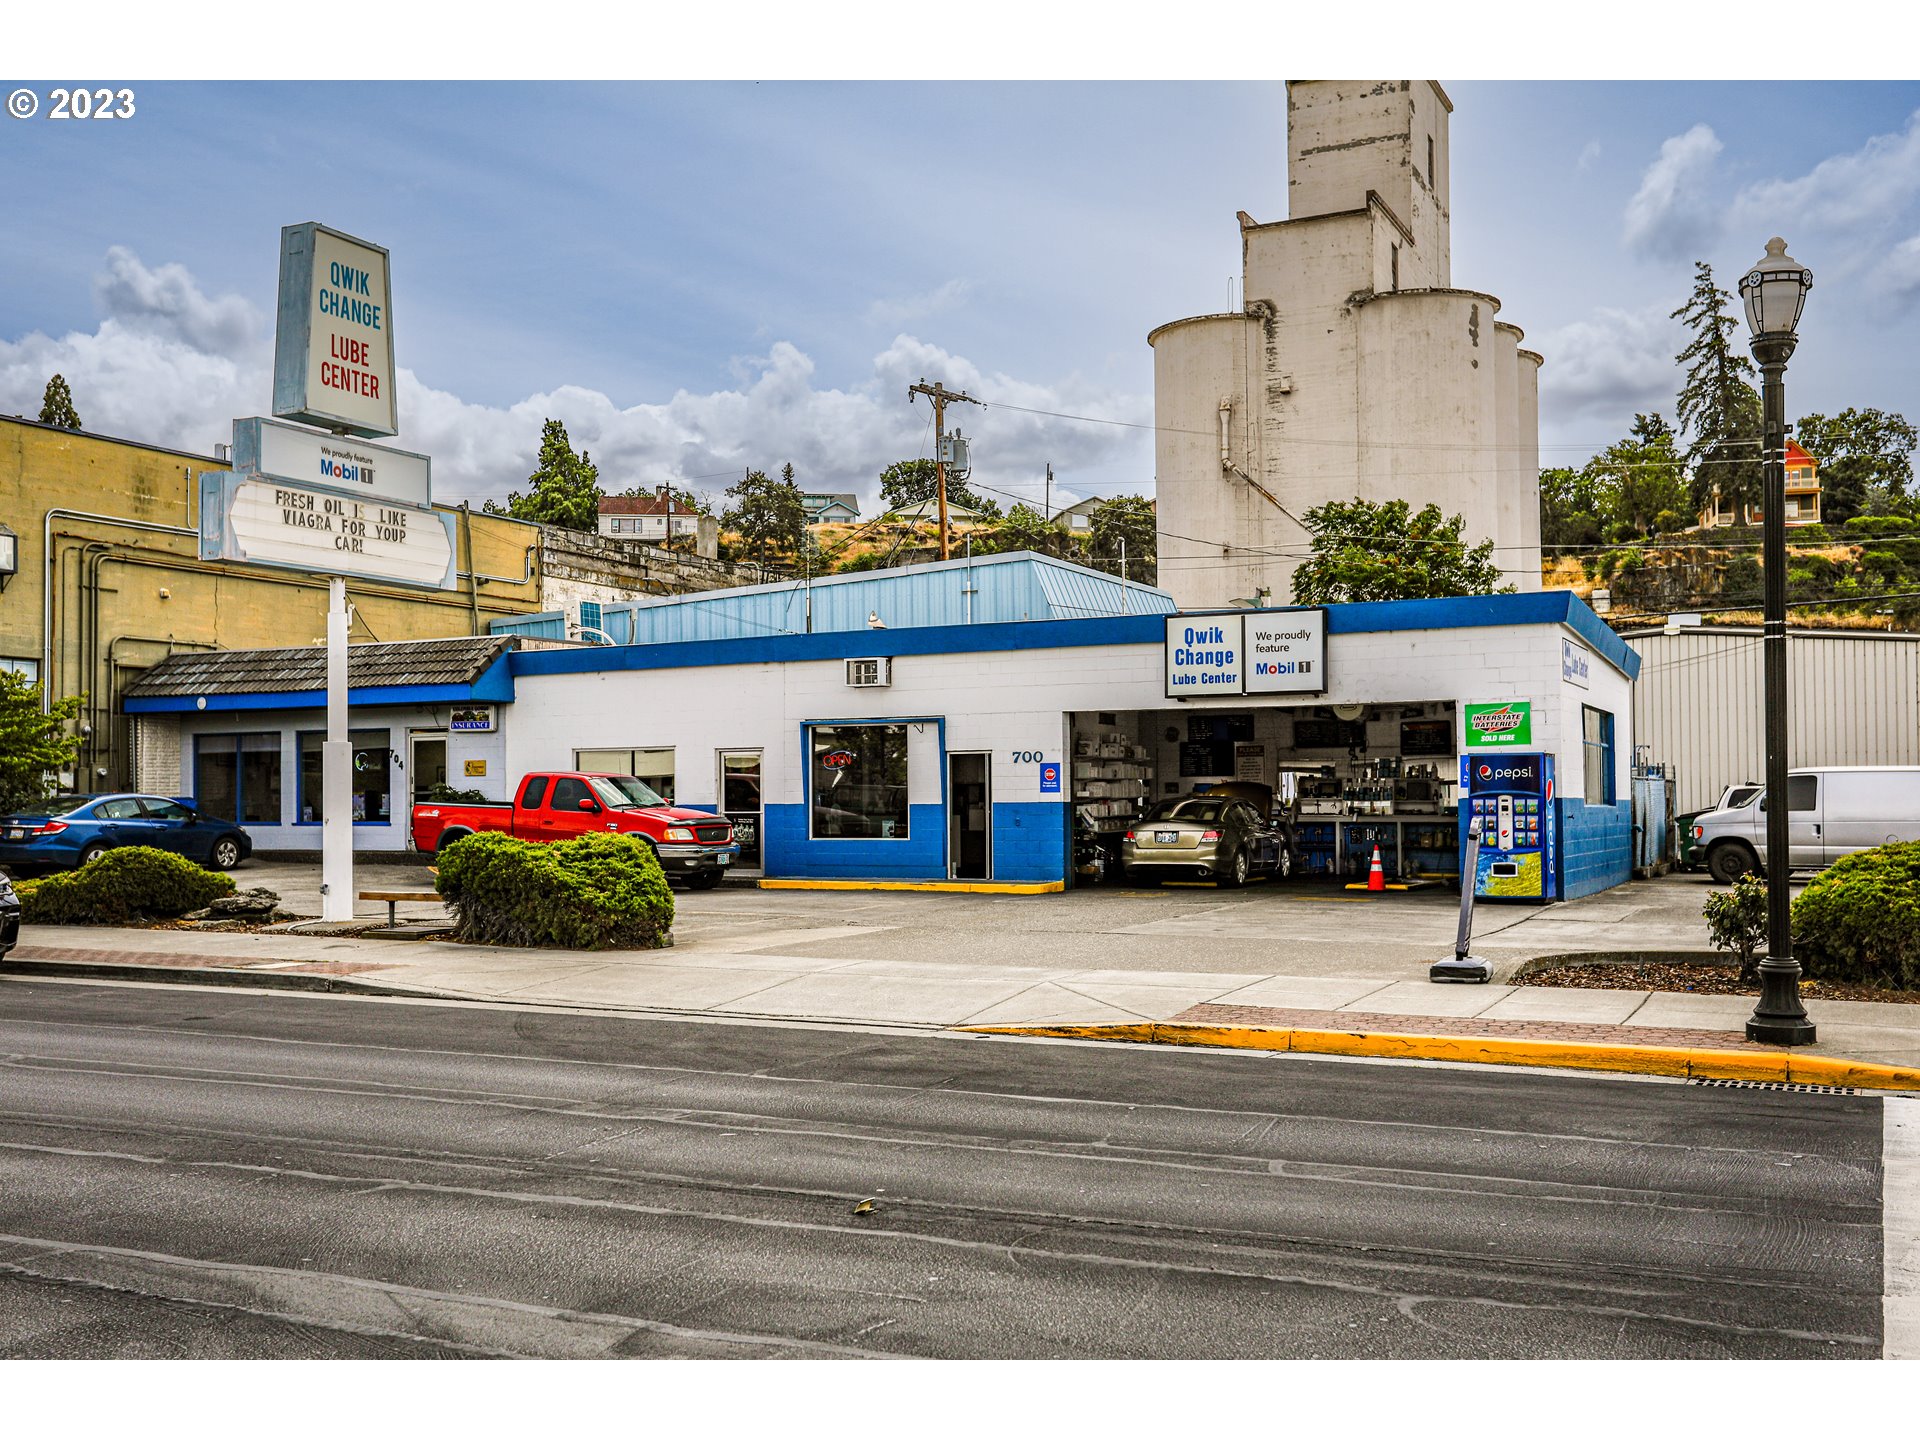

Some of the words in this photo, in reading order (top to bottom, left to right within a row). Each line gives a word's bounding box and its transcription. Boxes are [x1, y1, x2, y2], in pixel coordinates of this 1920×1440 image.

[330, 261, 370, 296] QWIK
[319, 288, 381, 330] CHANGE
[331, 333, 370, 367] LUBE
[321, 361, 380, 400] CENTER
[320, 446, 331, 456] We
[332, 449, 353, 462] proudly
[354, 453, 374, 465] feature
[320, 459, 359, 482] Mobil
[275, 489, 314, 511] FRESH
[324, 498, 345, 516] OIL
[353, 503, 366, 520] IS
[380, 508, 407, 527] LIKE
[283, 508, 332, 532] VIAGRA
[341, 519, 366, 537] FOR
[335, 536, 364, 553] CAR!
[1184, 627, 1224, 647] Qwik
[1255, 632, 1272, 641] We
[1274, 630, 1311, 643] proudly
[1175, 648, 1234, 667] Change
[1255, 643, 1290, 653] feature
[1256, 662, 1295, 675] Mobil
[1172, 673, 1197, 685] Lube
[1201, 672, 1237, 684] Center
[1473, 713, 1522, 721] INTERSTATE
[1474, 720, 1518, 728] BATTERIES
[389, 749, 404, 771] 704
[823, 754, 852, 766] OPEN
[1012, 751, 1043, 763] 700
[1495, 766, 1532, 780] pepsi
[1547, 814, 1555, 874] pepsi
